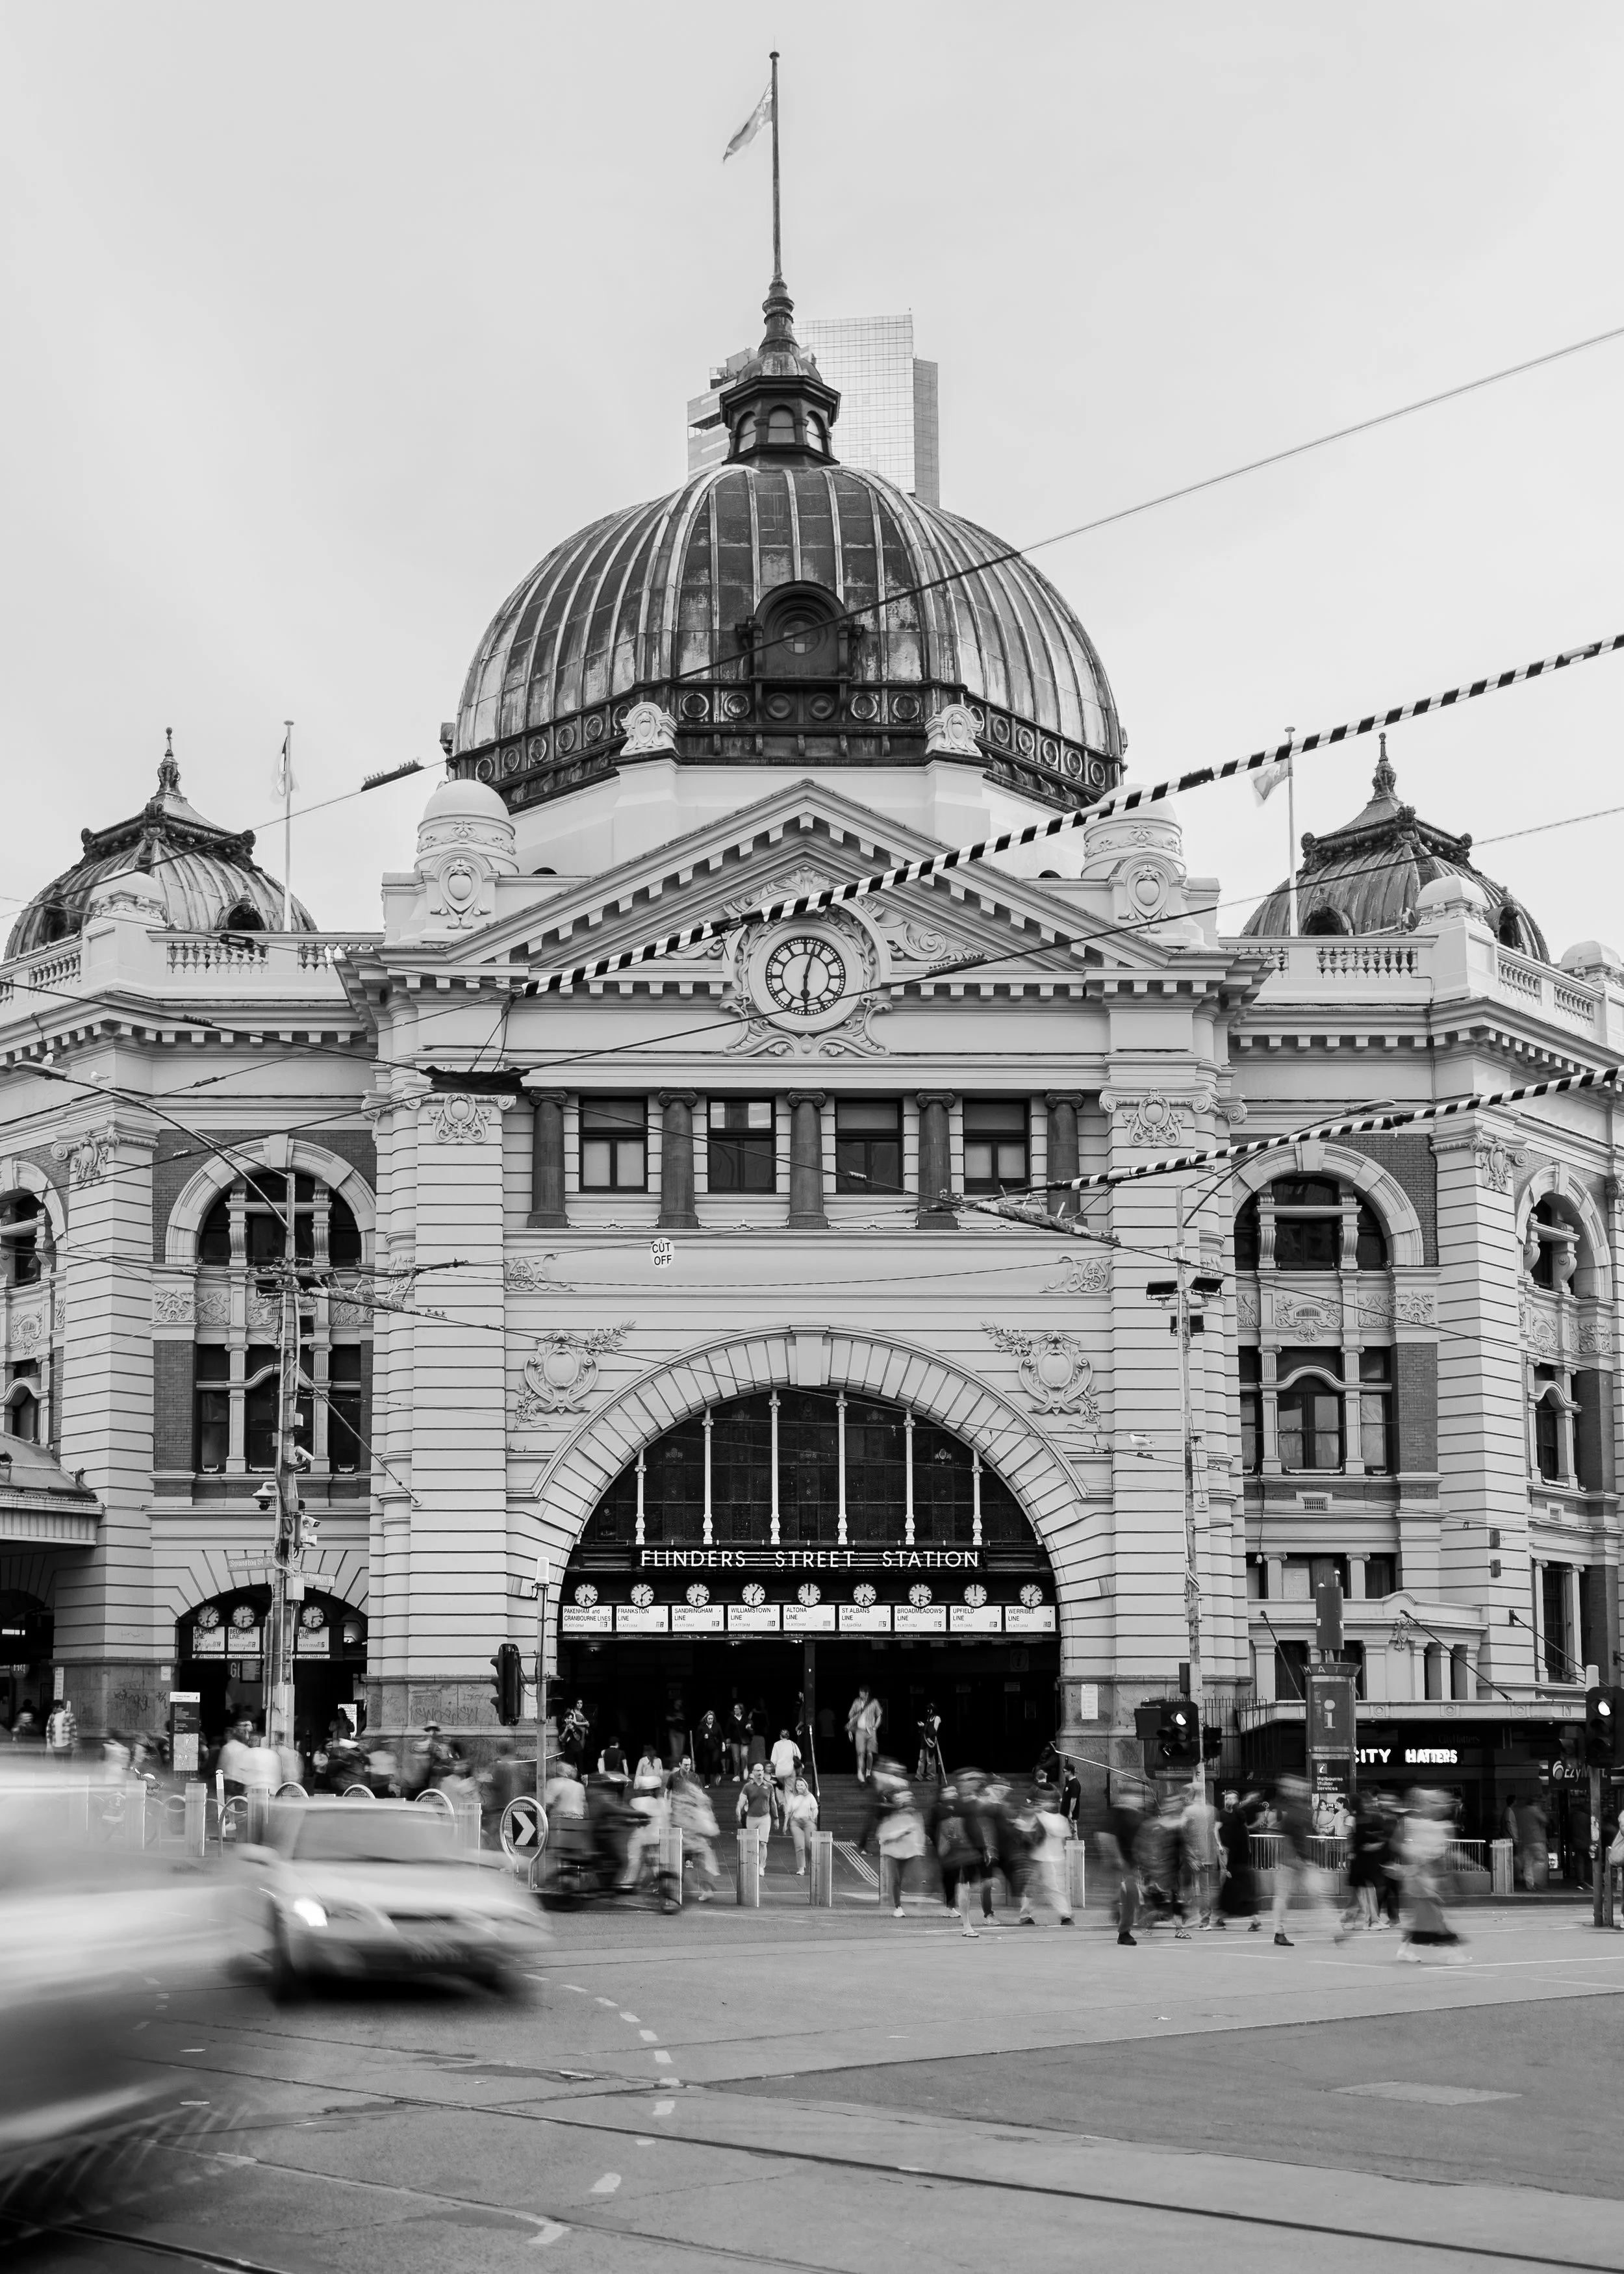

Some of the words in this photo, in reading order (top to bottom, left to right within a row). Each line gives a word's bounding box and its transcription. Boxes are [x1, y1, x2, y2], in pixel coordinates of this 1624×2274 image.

[652, 1242, 670, 1253] CUT
[653, 1255, 672, 1266] OFF
[641, 1550, 746, 1567] FLINDERS
[775, 1550, 854, 1567] STREET
[882, 1550, 978, 1567] STATION
[1405, 1749, 1458, 1763] HATTERS
